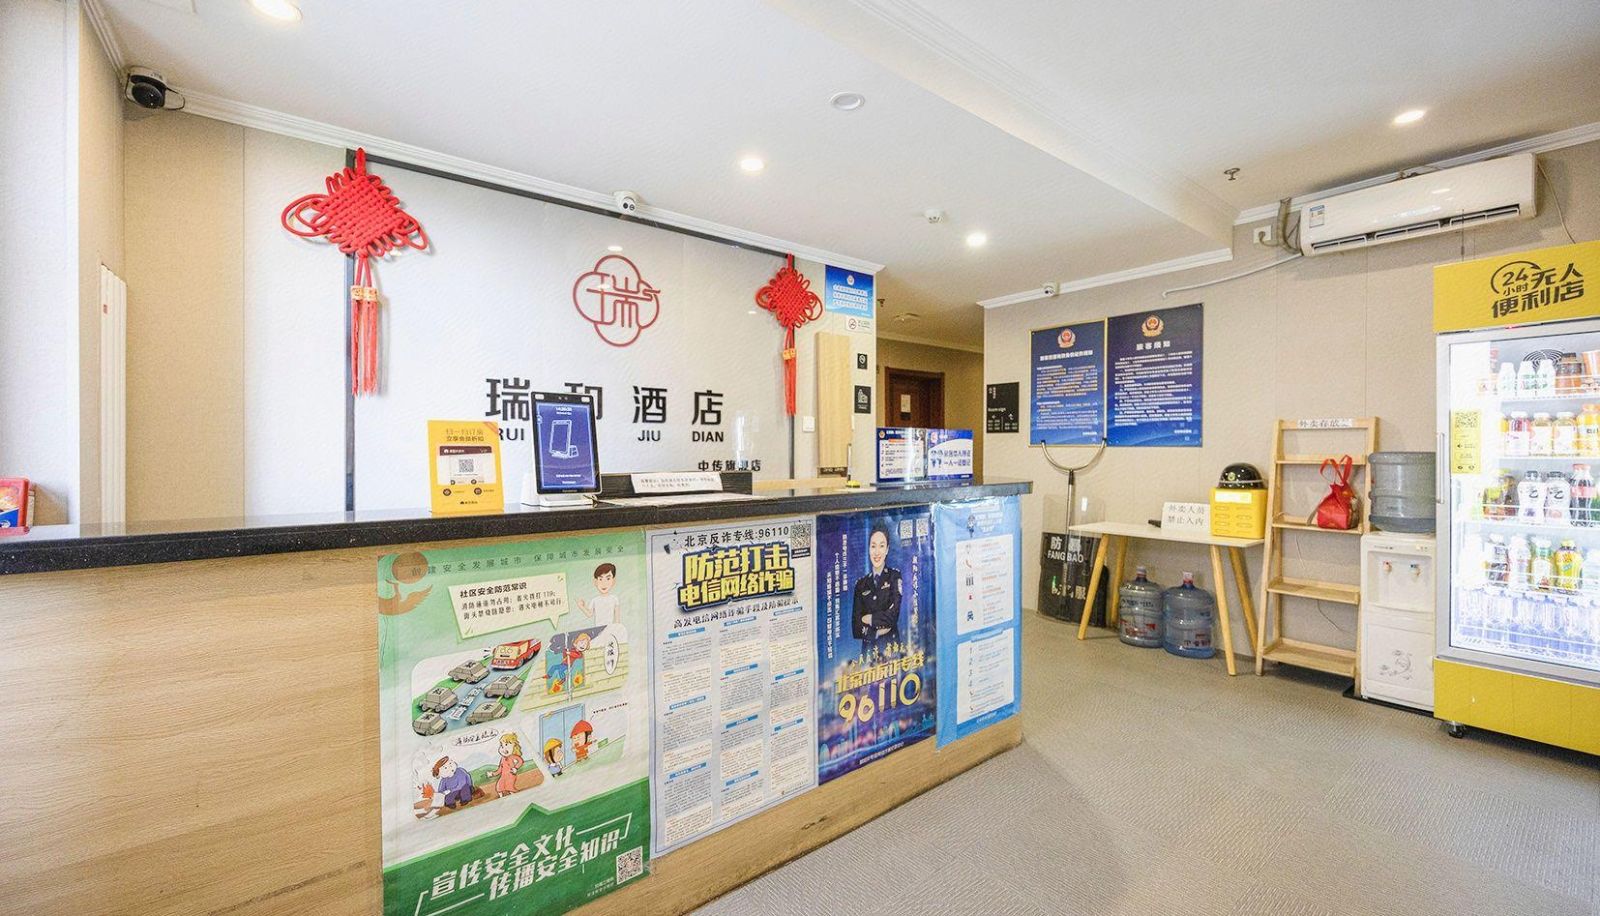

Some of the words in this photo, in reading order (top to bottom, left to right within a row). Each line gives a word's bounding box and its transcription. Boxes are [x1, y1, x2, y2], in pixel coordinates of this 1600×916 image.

[1502, 268, 1529, 287] 24
[1503, 283, 1528, 296] 小时
[1531, 263, 1584, 289] 无人
[1491, 280, 1584, 318] 便利店
[498, 428, 525, 441] RUI
[637, 430, 661, 442] JIU
[692, 430, 724, 442] DIAN
[685, 543, 789, 585] 防范打击
[1047, 550, 1065, 561] FANG
[1066, 552, 1084, 563] BAO
[460, 581, 527, 598] 社区安全防范常识
[679, 567, 794, 607] 电信网络诈骗
[835, 651, 925, 694] 北京市反诈专线
[838, 673, 921, 724] 96110
[430, 825, 575, 901] 宣传安全文化
[489, 828, 620, 901] 传播安全知识
